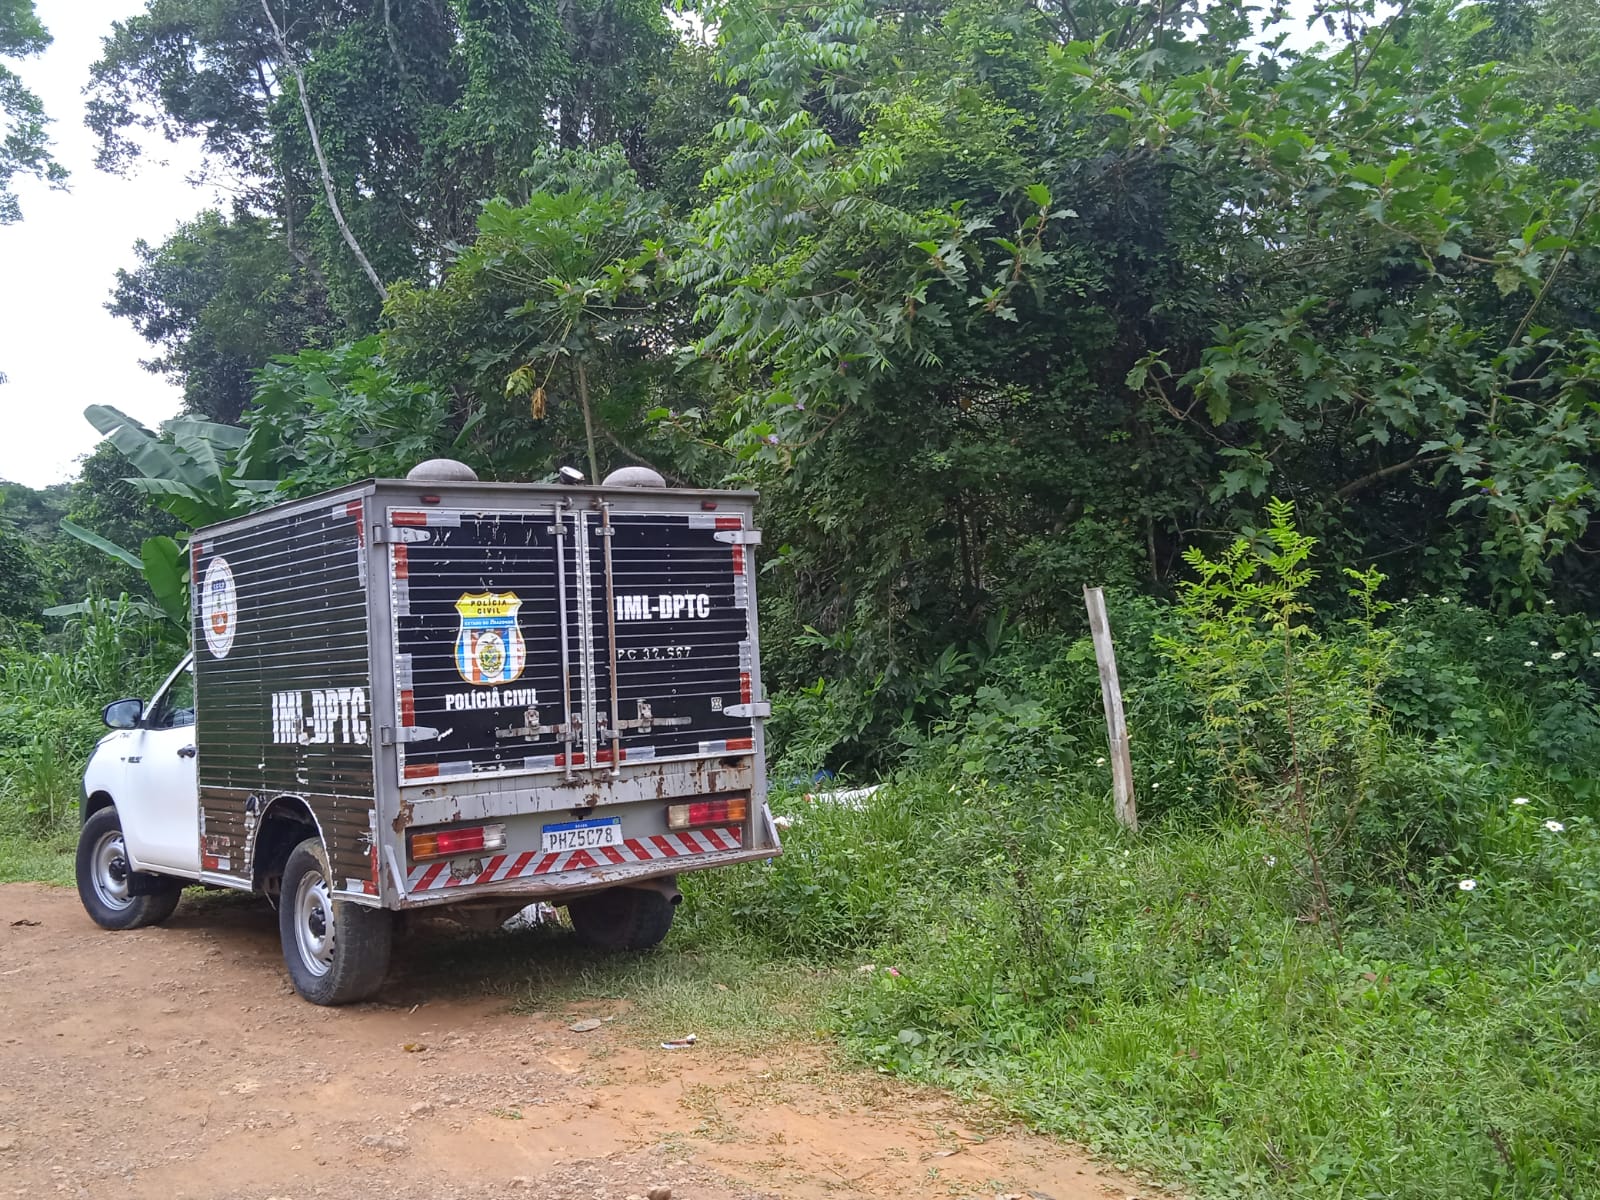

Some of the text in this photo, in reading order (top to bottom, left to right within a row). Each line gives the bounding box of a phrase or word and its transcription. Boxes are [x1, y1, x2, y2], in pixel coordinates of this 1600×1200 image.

[470, 598, 507, 607] POLÍCIA
[476, 607, 501, 615] CIVIL
[616, 593, 710, 620] IML-DPTC
[617, 649, 637, 660] PC
[445, 687, 539, 711] POLÍCIA CIVIL
[272, 687, 368, 745] IML-DPTC
[549, 827, 613, 851] PHZ5C78
